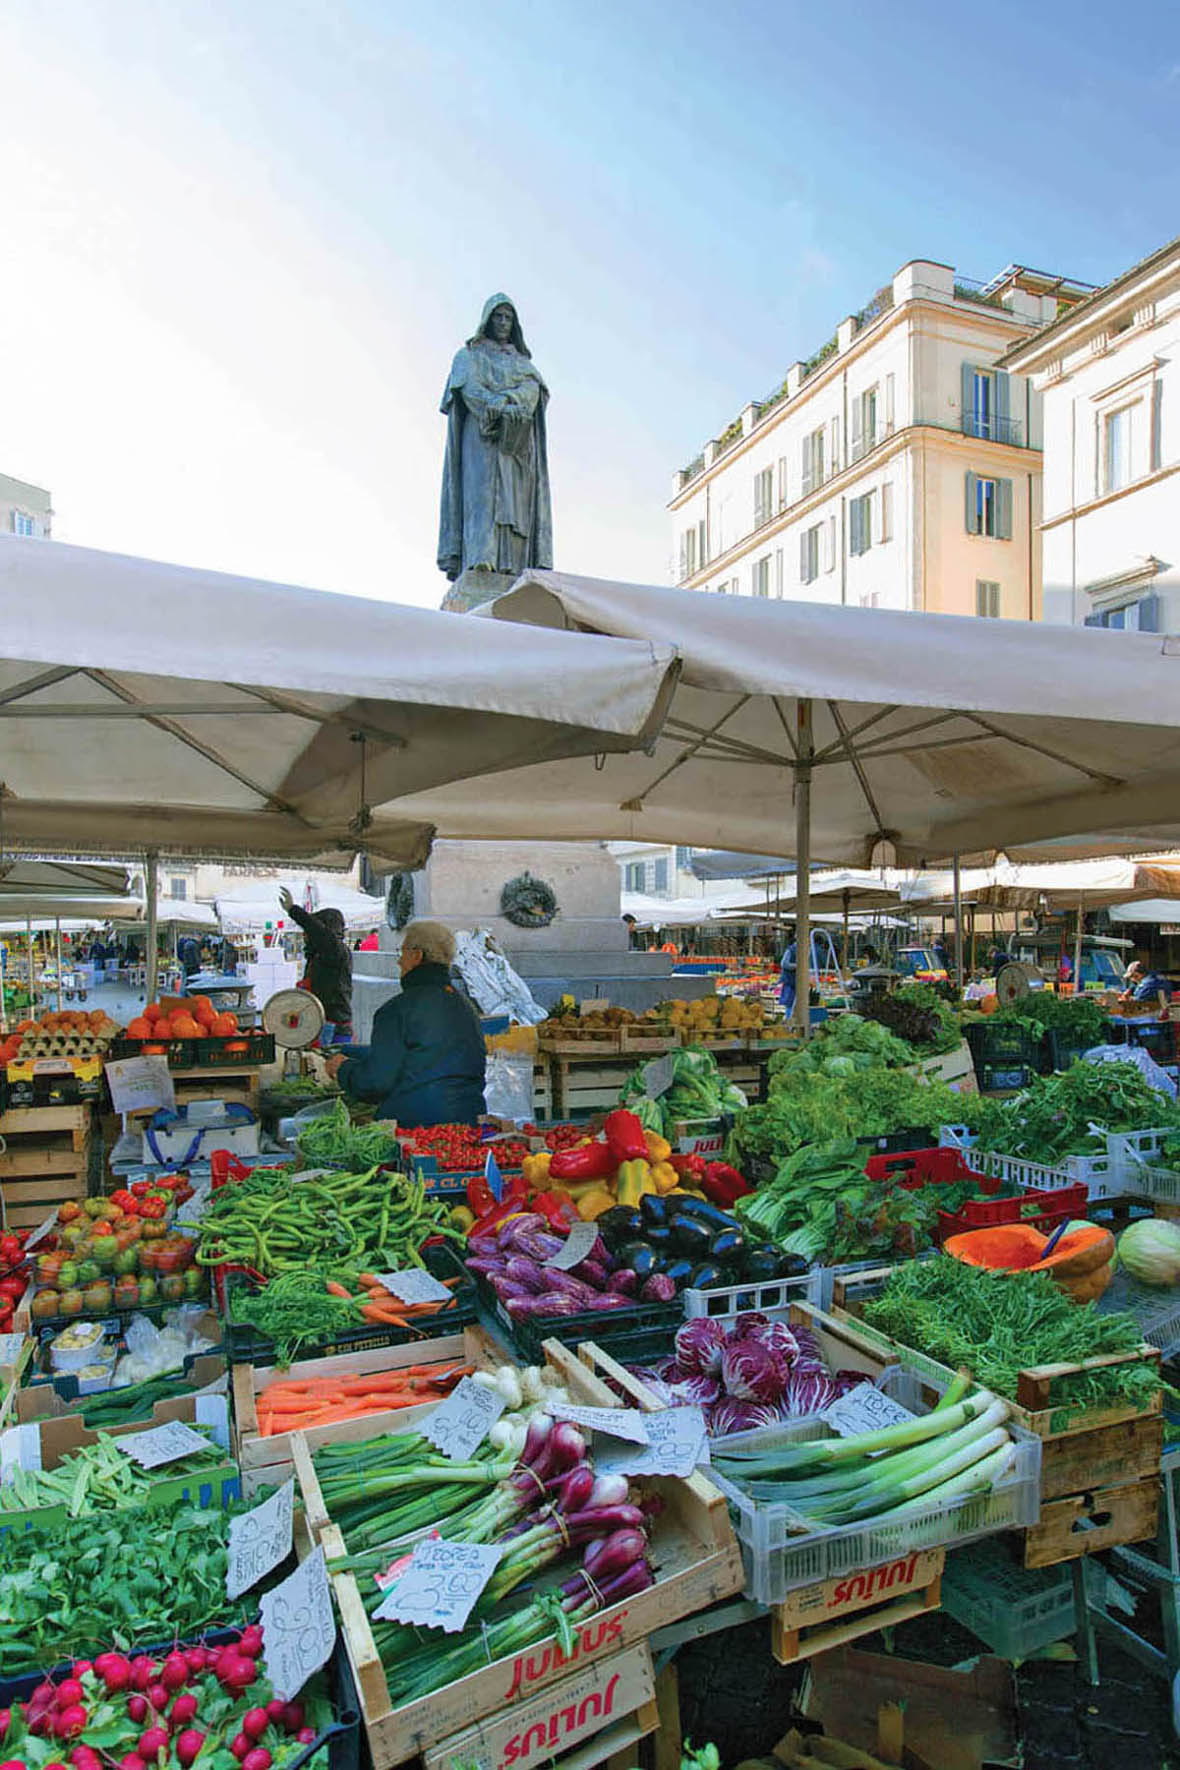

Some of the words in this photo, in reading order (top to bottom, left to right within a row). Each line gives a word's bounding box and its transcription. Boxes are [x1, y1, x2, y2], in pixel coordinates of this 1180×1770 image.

[826, 1551, 921, 1609] JULIUS
[503, 1609, 629, 1699] JULIUS
[500, 1672, 621, 1769] JULIUS
